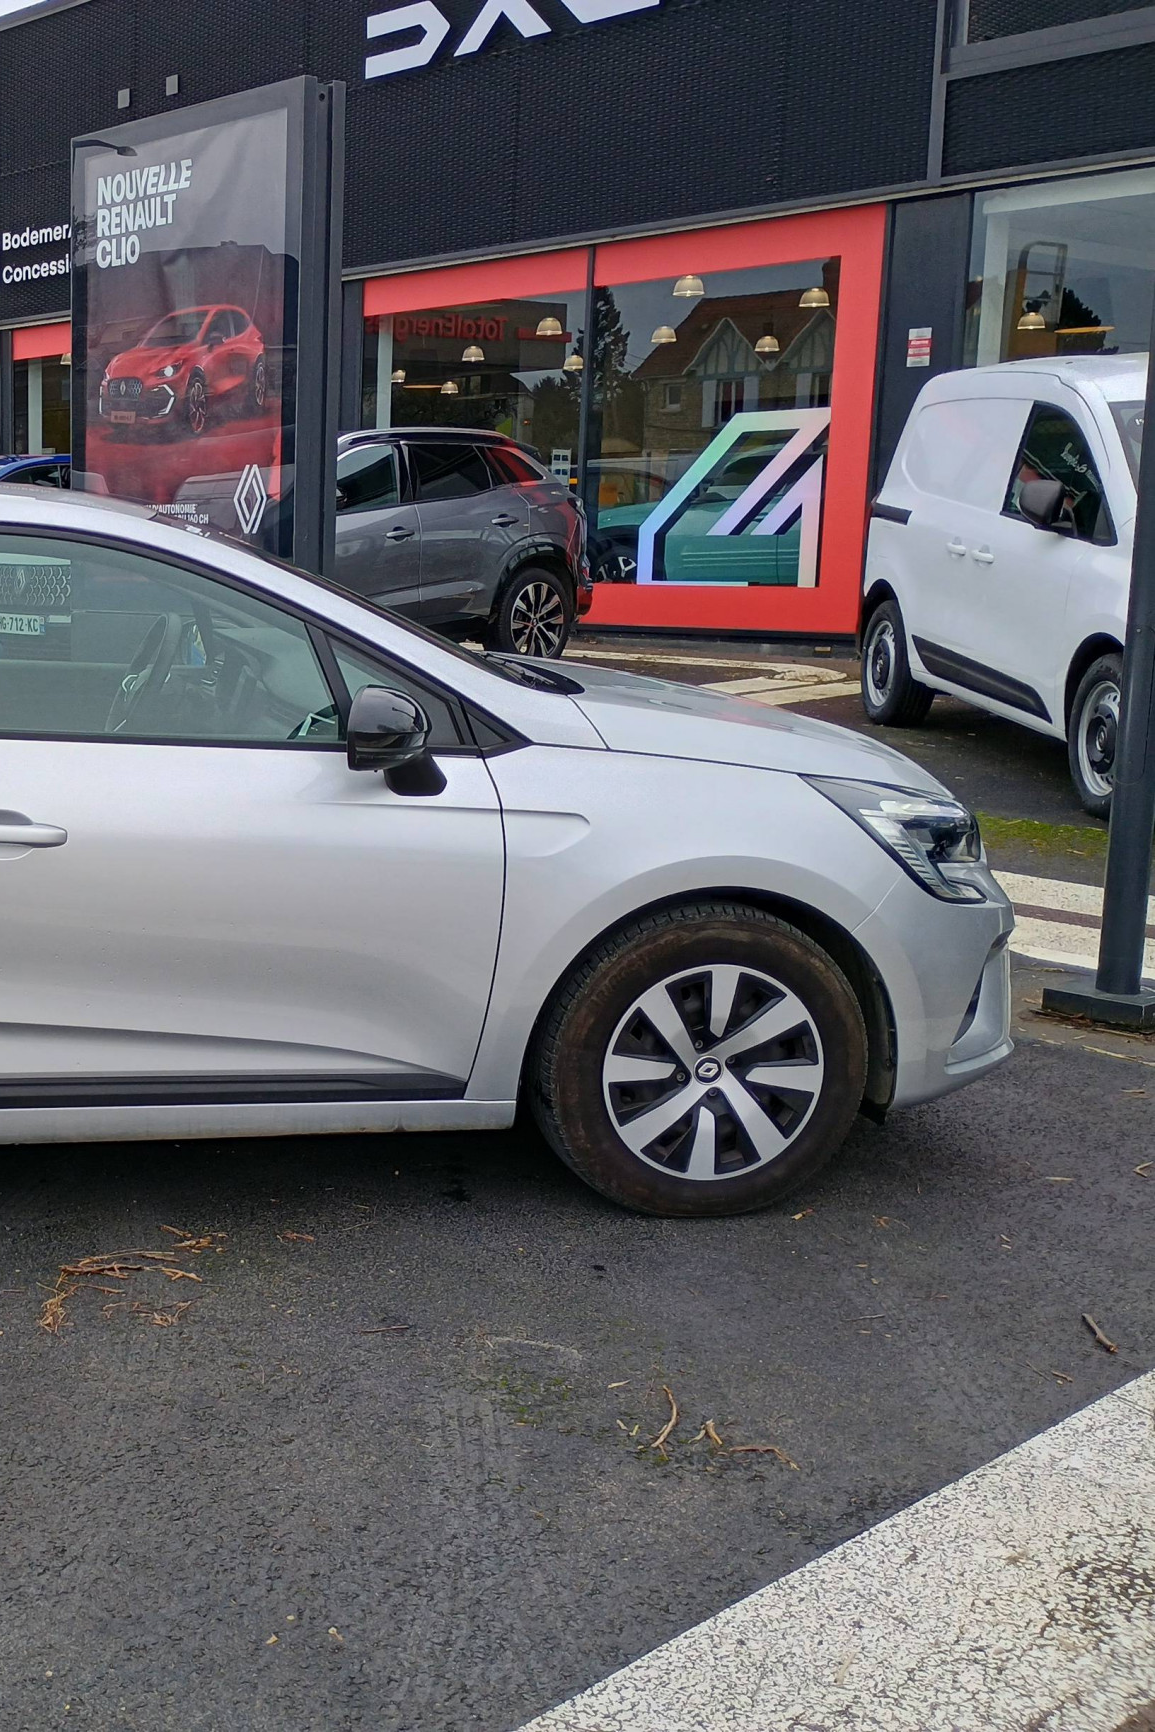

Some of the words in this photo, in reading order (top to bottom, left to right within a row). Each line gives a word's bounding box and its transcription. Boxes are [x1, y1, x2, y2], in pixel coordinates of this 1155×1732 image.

[97, 158, 193, 206] NOUVELLE
[96, 193, 177, 238] RENAULT
[2, 253, 72, 284] Concessi
[96, 234, 140, 269] CLIO
[199, 513, 209, 525] CH
